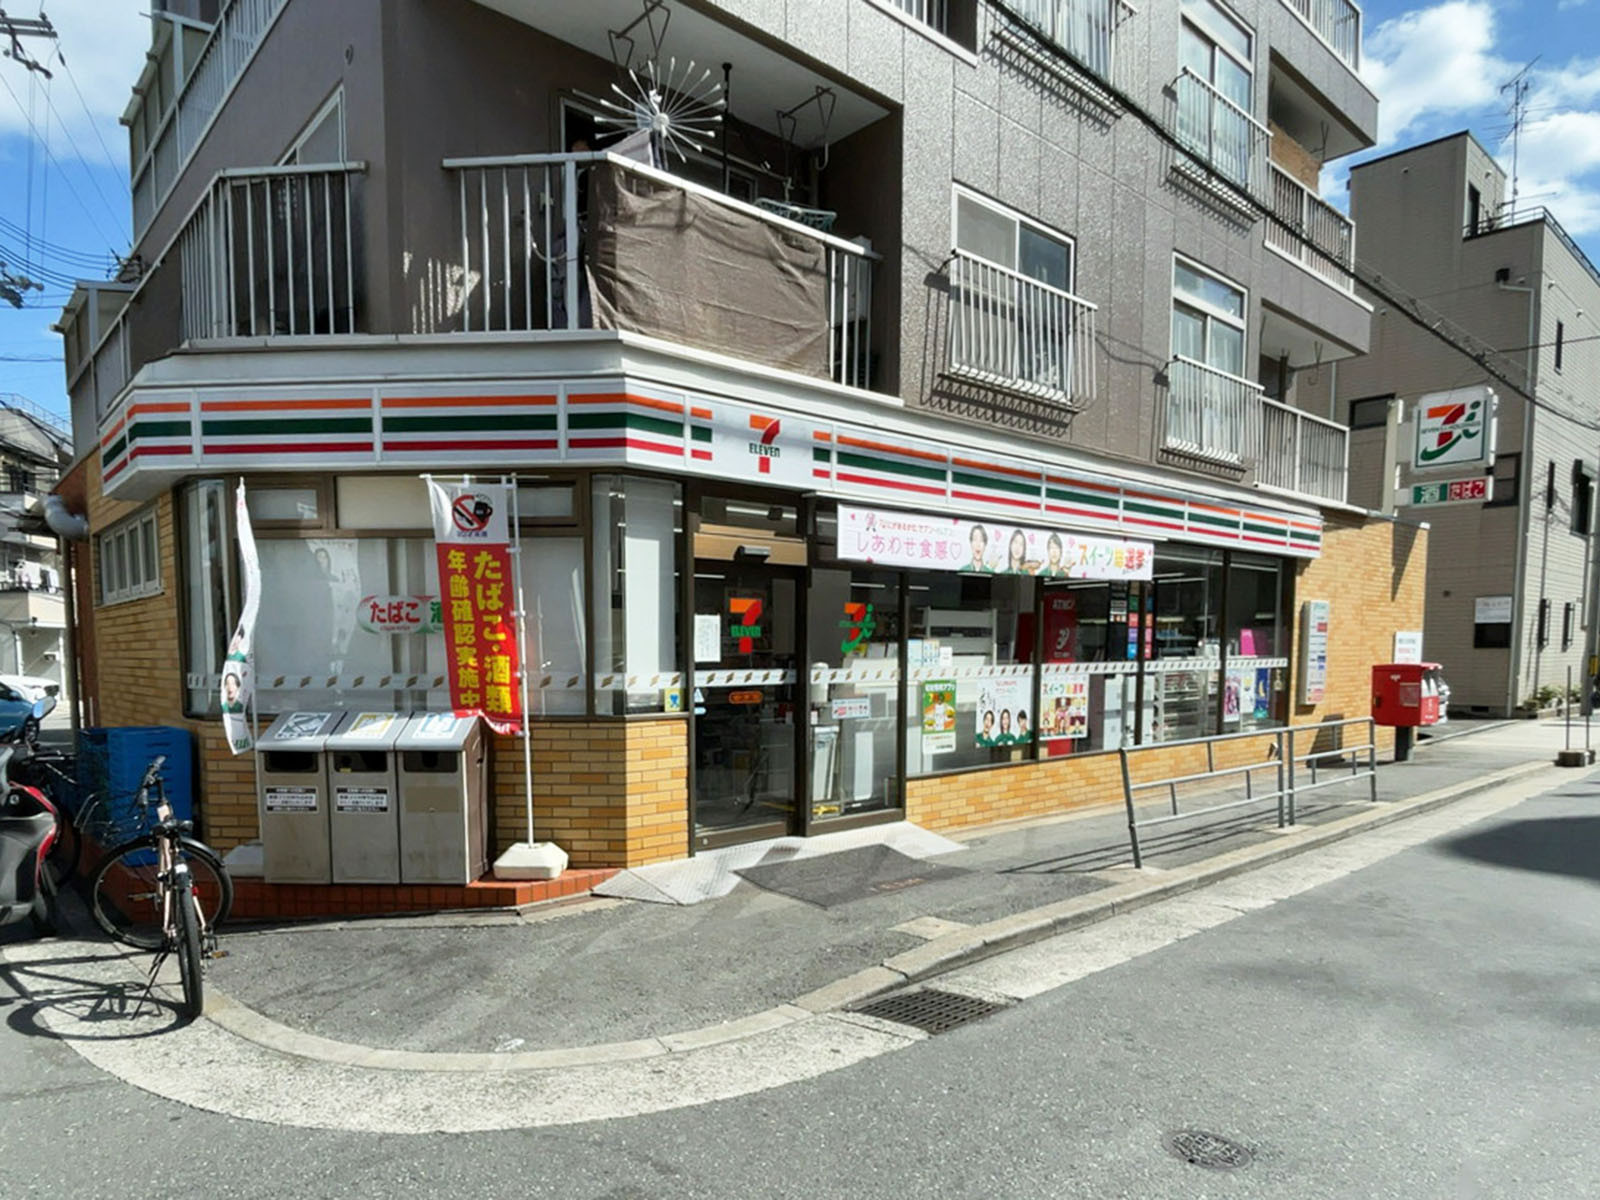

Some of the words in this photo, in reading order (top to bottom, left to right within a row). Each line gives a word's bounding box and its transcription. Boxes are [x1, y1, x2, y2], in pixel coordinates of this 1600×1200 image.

[749, 414, 780, 473] 7
[1421, 485, 1440, 503] 酒
[1451, 481, 1485, 500] たばこ
[370, 601, 420, 624] たばこ
[447, 549, 480, 707] 年齢確認実施中
[473, 551, 513, 714] たばこ・酒類
